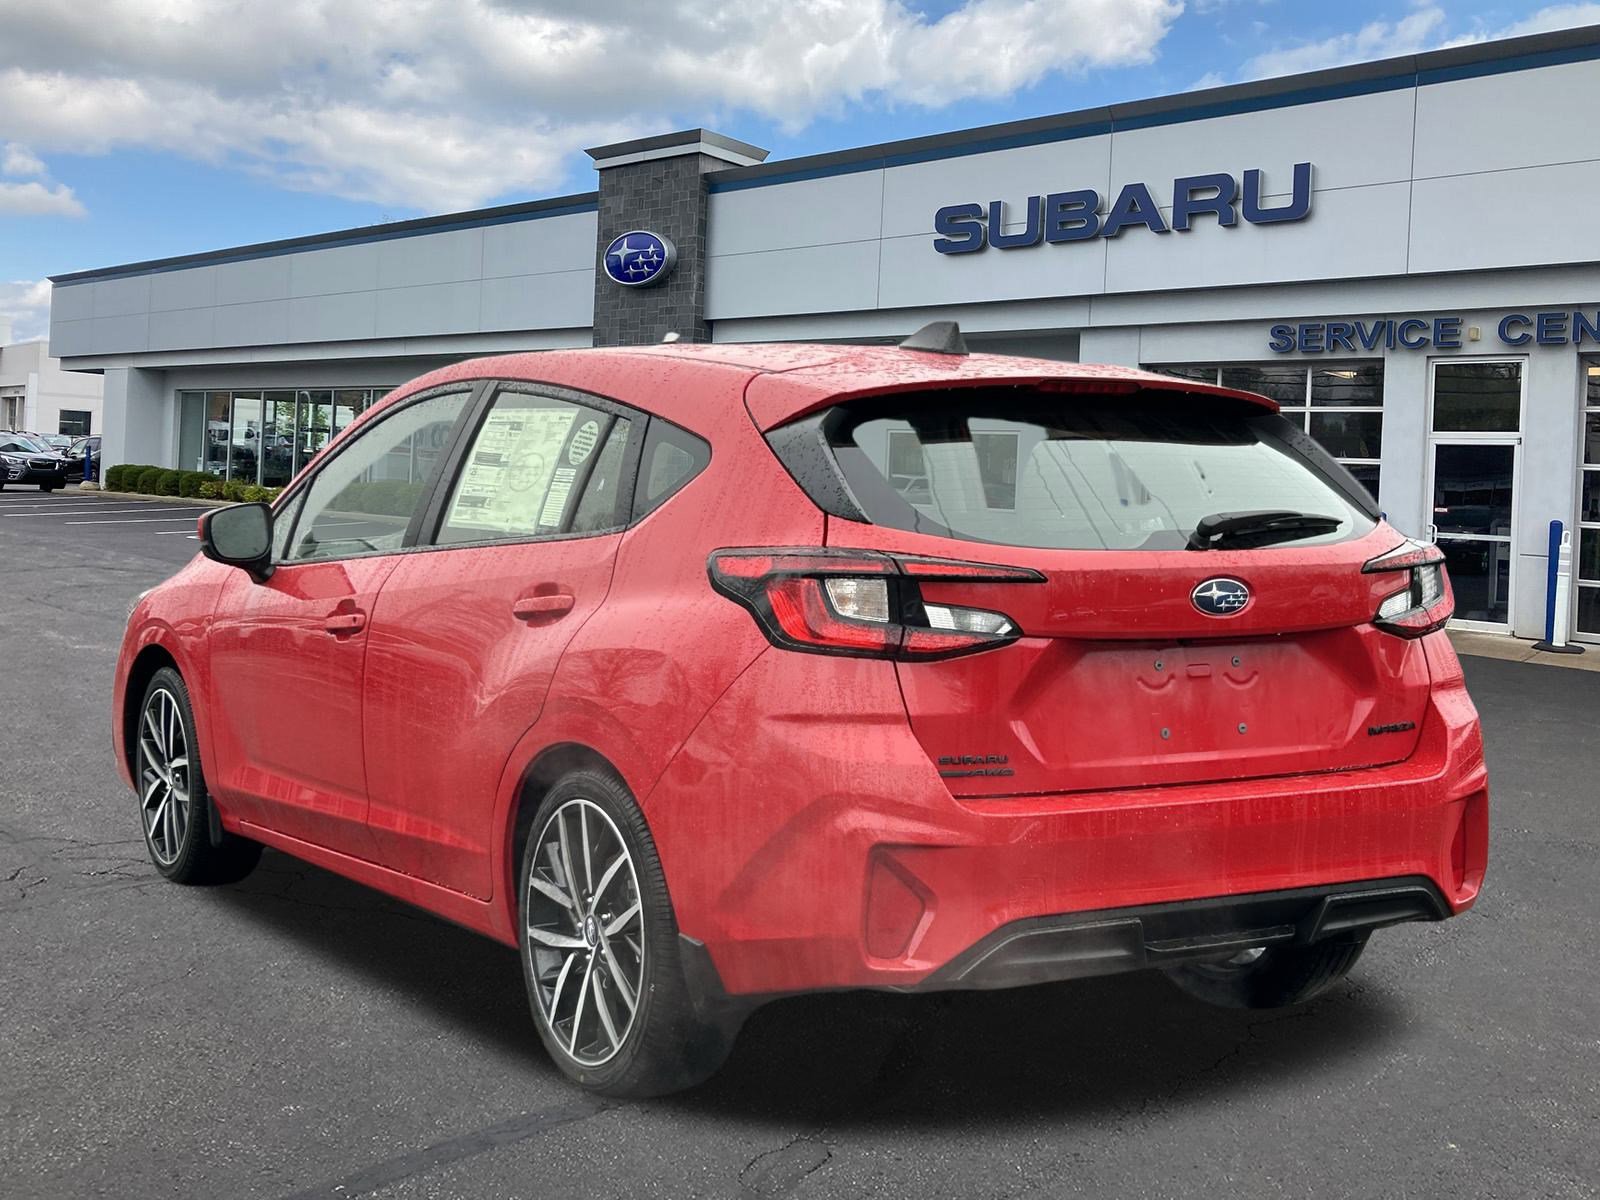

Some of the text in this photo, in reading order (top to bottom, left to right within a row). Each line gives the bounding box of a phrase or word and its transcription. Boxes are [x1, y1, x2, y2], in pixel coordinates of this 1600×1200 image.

[934, 161, 1314, 255] SUBARU
[1269, 311, 1600, 352] SERVICE CEN
